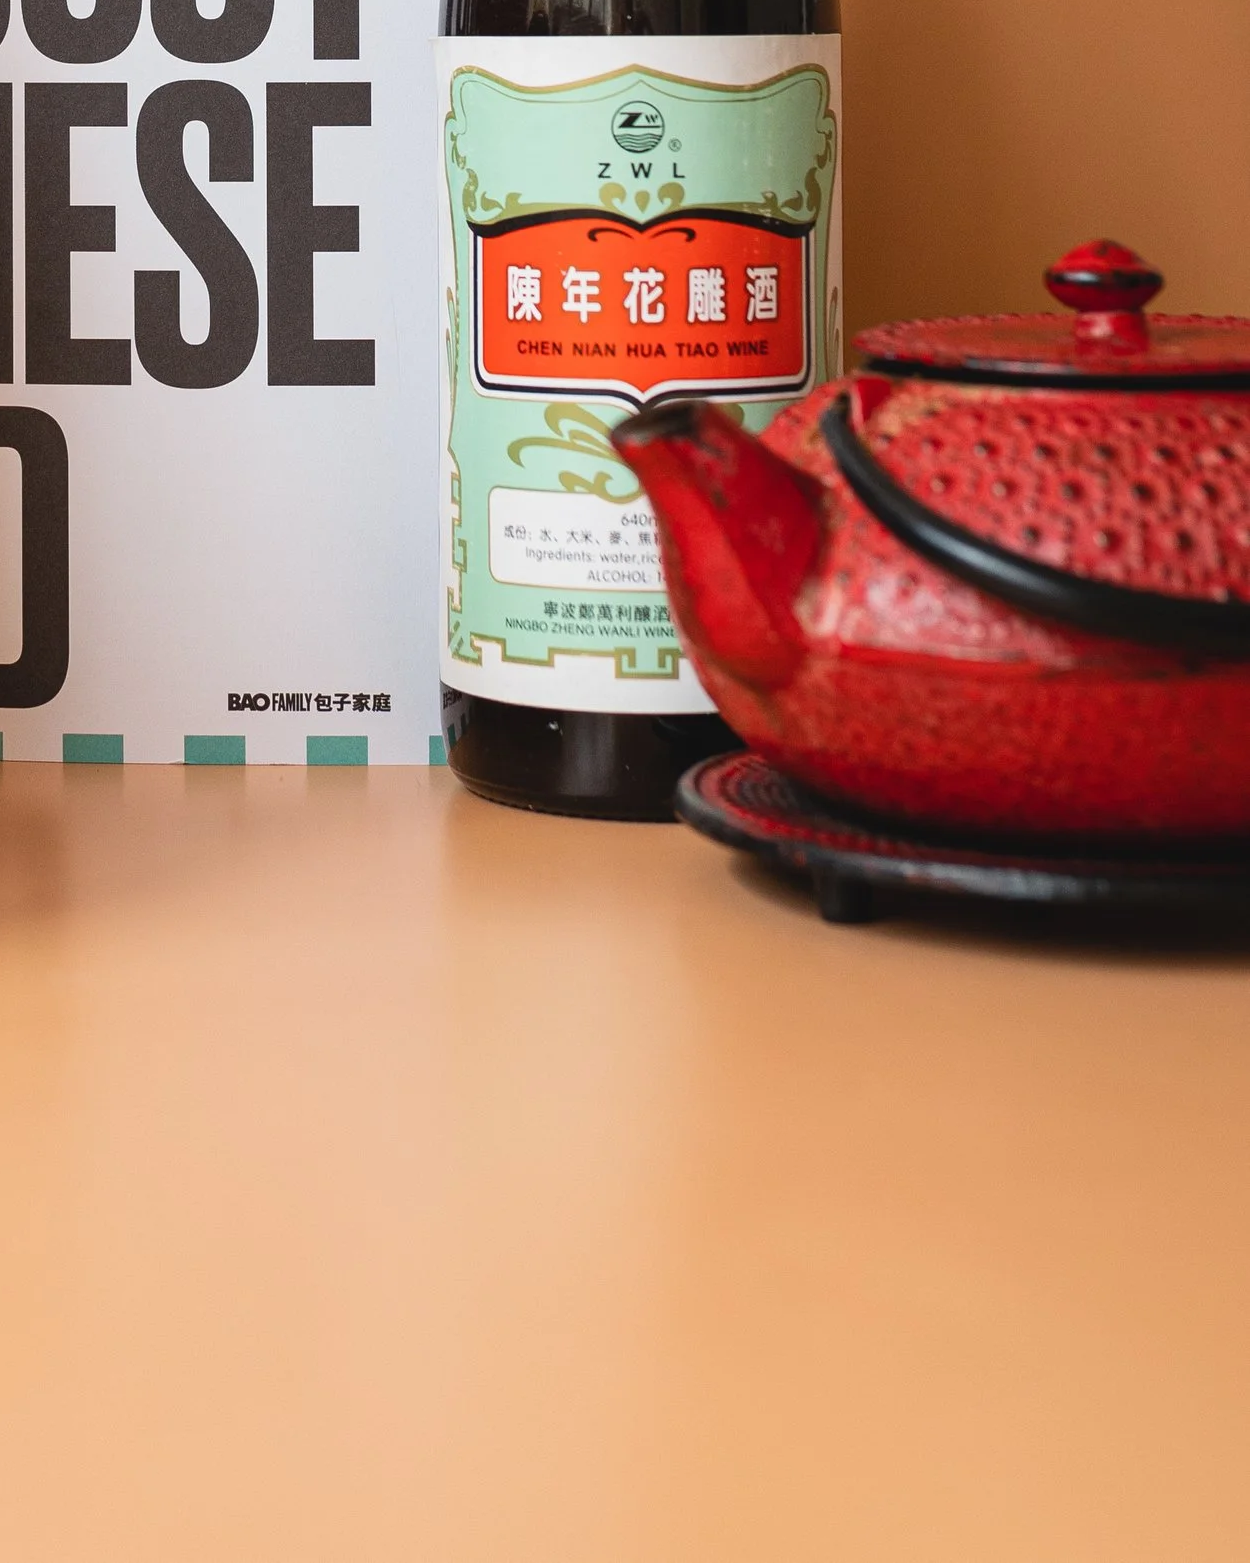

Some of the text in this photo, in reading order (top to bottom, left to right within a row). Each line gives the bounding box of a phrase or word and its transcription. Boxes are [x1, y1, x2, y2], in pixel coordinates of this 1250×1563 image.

[507, 264, 779, 324] 陳年花雕酒
[516, 339, 770, 358] CHEN NIAN HUA TIAO WINE
[505, 616, 549, 634] NINGBO
[551, 619, 595, 636] ZHENG
[598, 624, 640, 637] WANLI
[227, 692, 392, 713] BAO FAMILY 包子家庭
